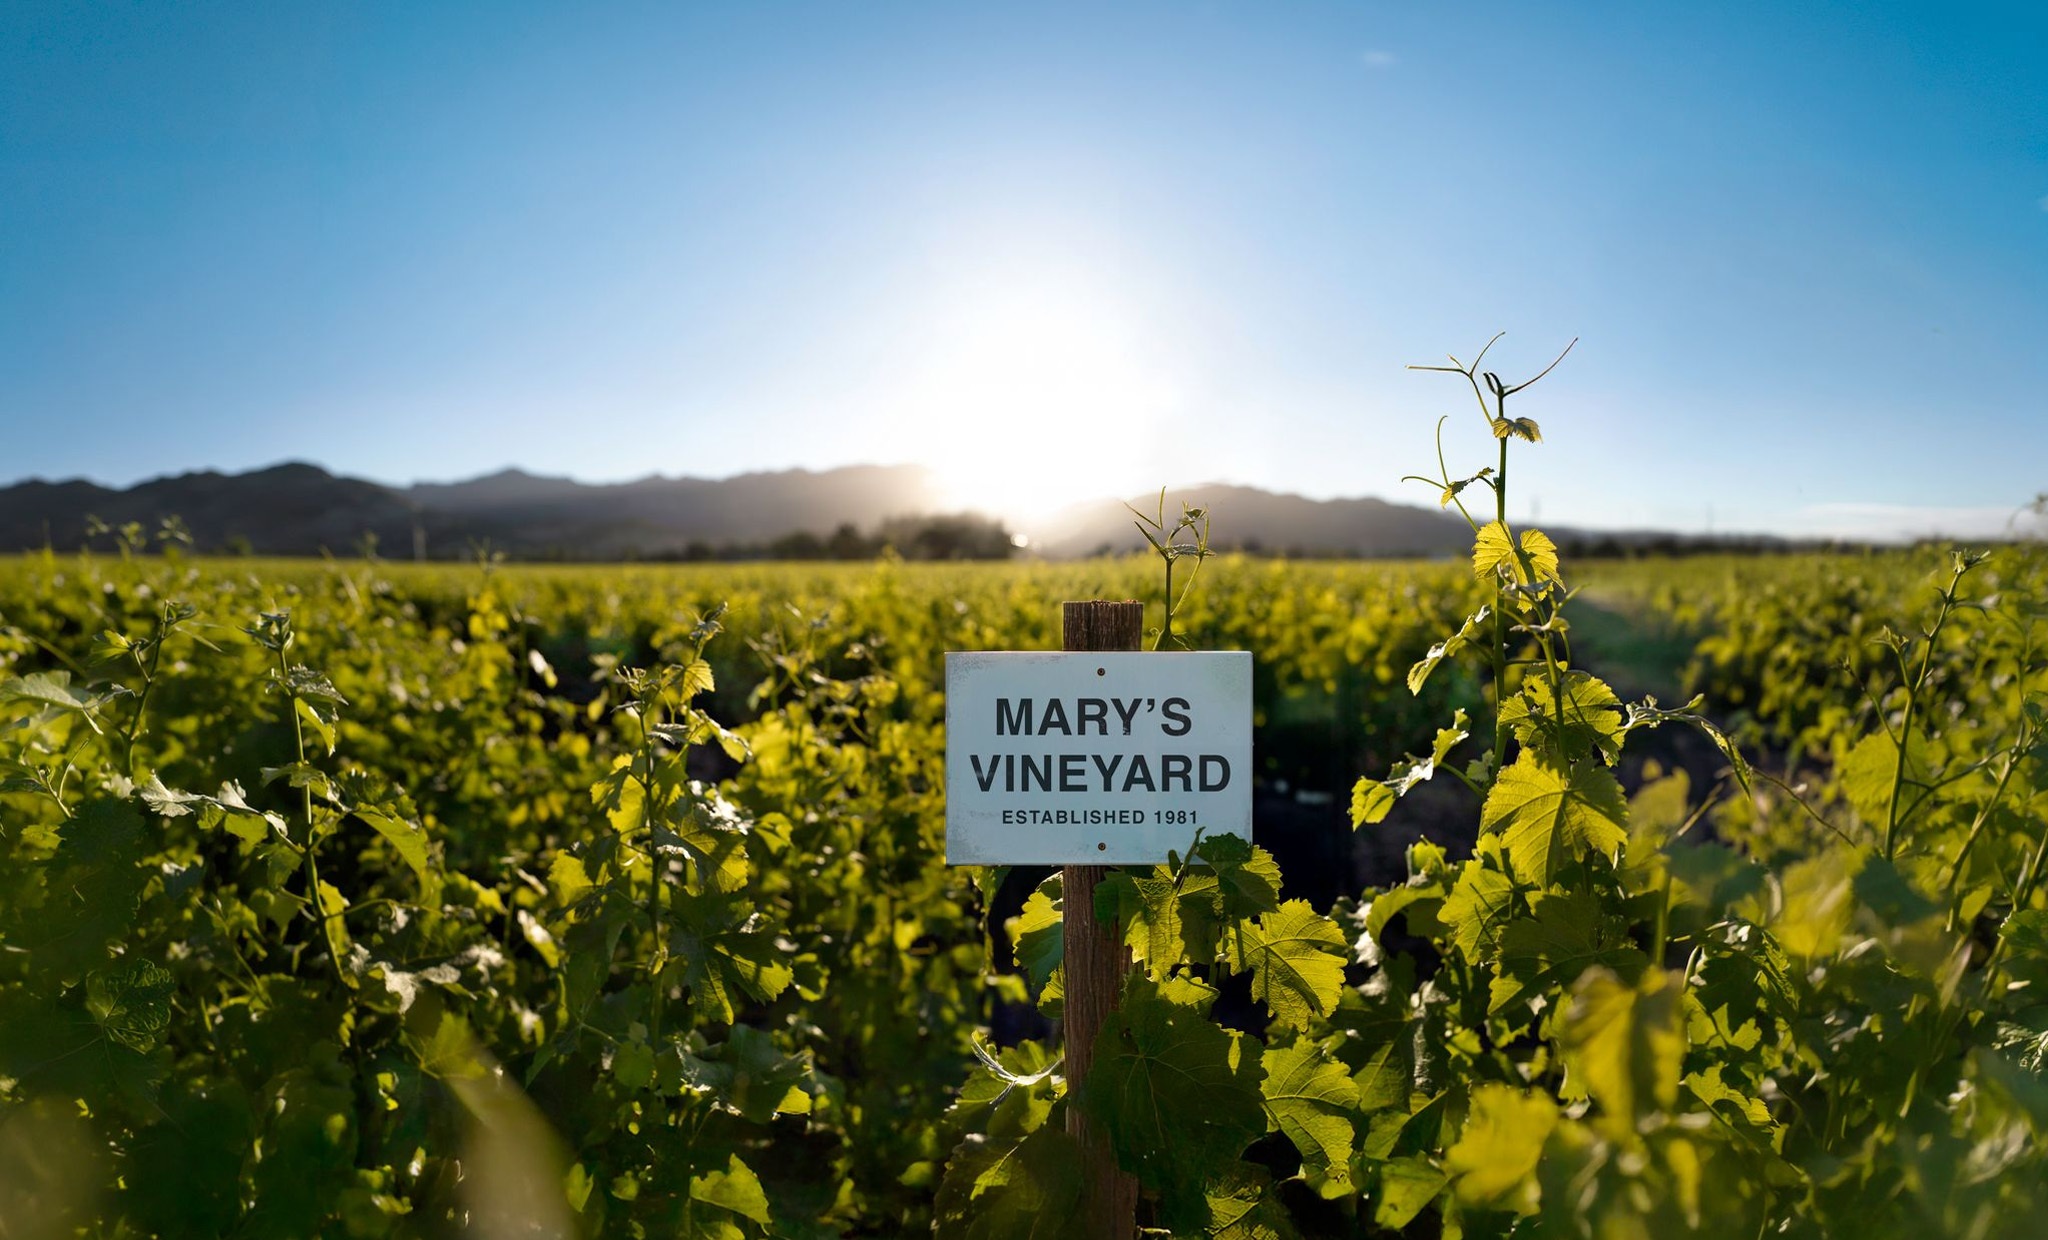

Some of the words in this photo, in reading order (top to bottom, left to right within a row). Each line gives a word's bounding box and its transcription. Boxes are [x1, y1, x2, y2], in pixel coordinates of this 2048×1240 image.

[996, 697, 1192, 737] MARY’S
[970, 754, 1231, 793] VINEYARD
[1002, 809, 1145, 825] ESTABLISHED
[1154, 809, 1197, 825] 1981
